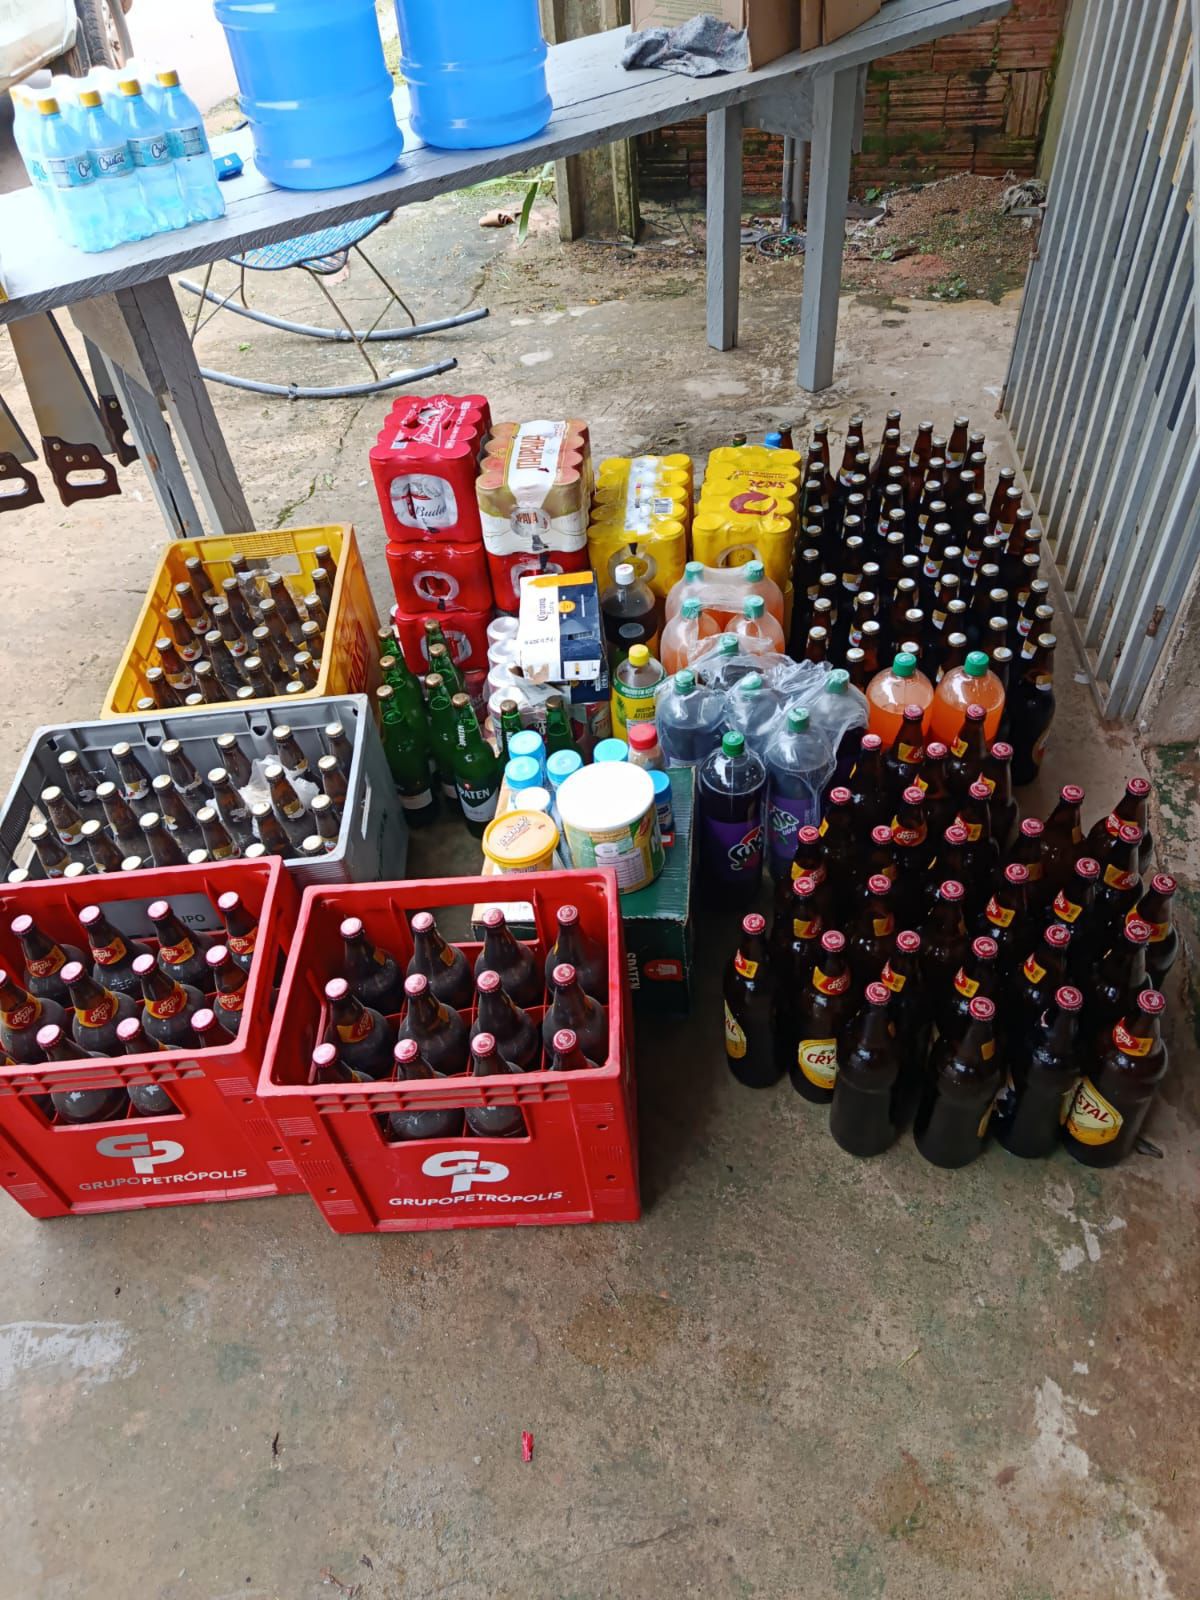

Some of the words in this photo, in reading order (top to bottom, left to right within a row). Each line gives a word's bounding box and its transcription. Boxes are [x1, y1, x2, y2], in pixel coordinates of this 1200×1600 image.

[537, 598, 548, 622] Corona
[806, 1053, 836, 1066] CRY
[1077, 1093, 1110, 1124] STAL
